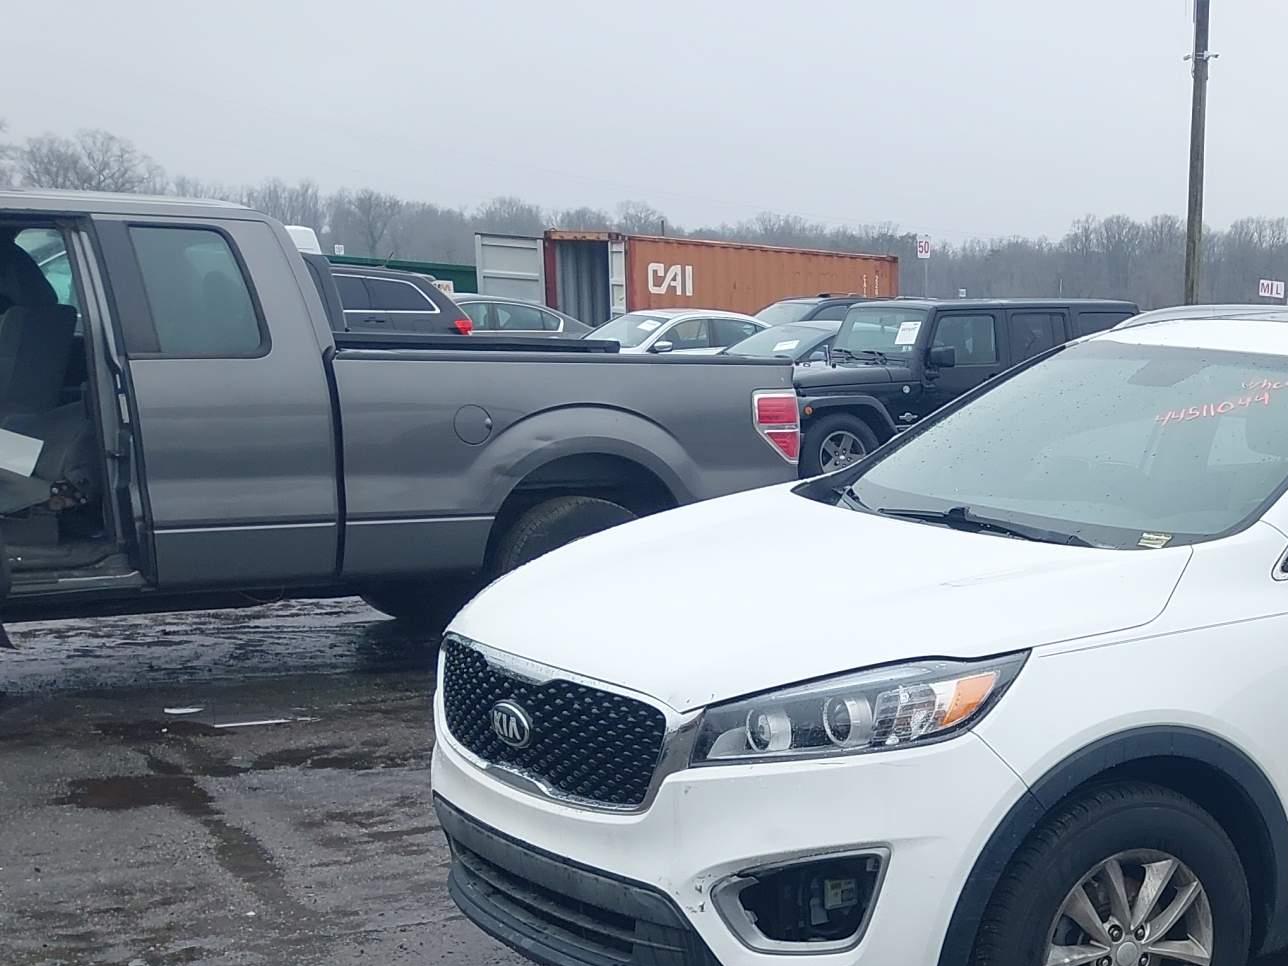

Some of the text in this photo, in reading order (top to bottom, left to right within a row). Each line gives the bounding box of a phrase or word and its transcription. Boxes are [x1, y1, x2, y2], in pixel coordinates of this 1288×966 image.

[918, 240, 930, 254] 50
[647, 262, 693, 297] CAI
[1155, 391, 1270, 427] 44511044
[493, 709, 522, 741] KIA
